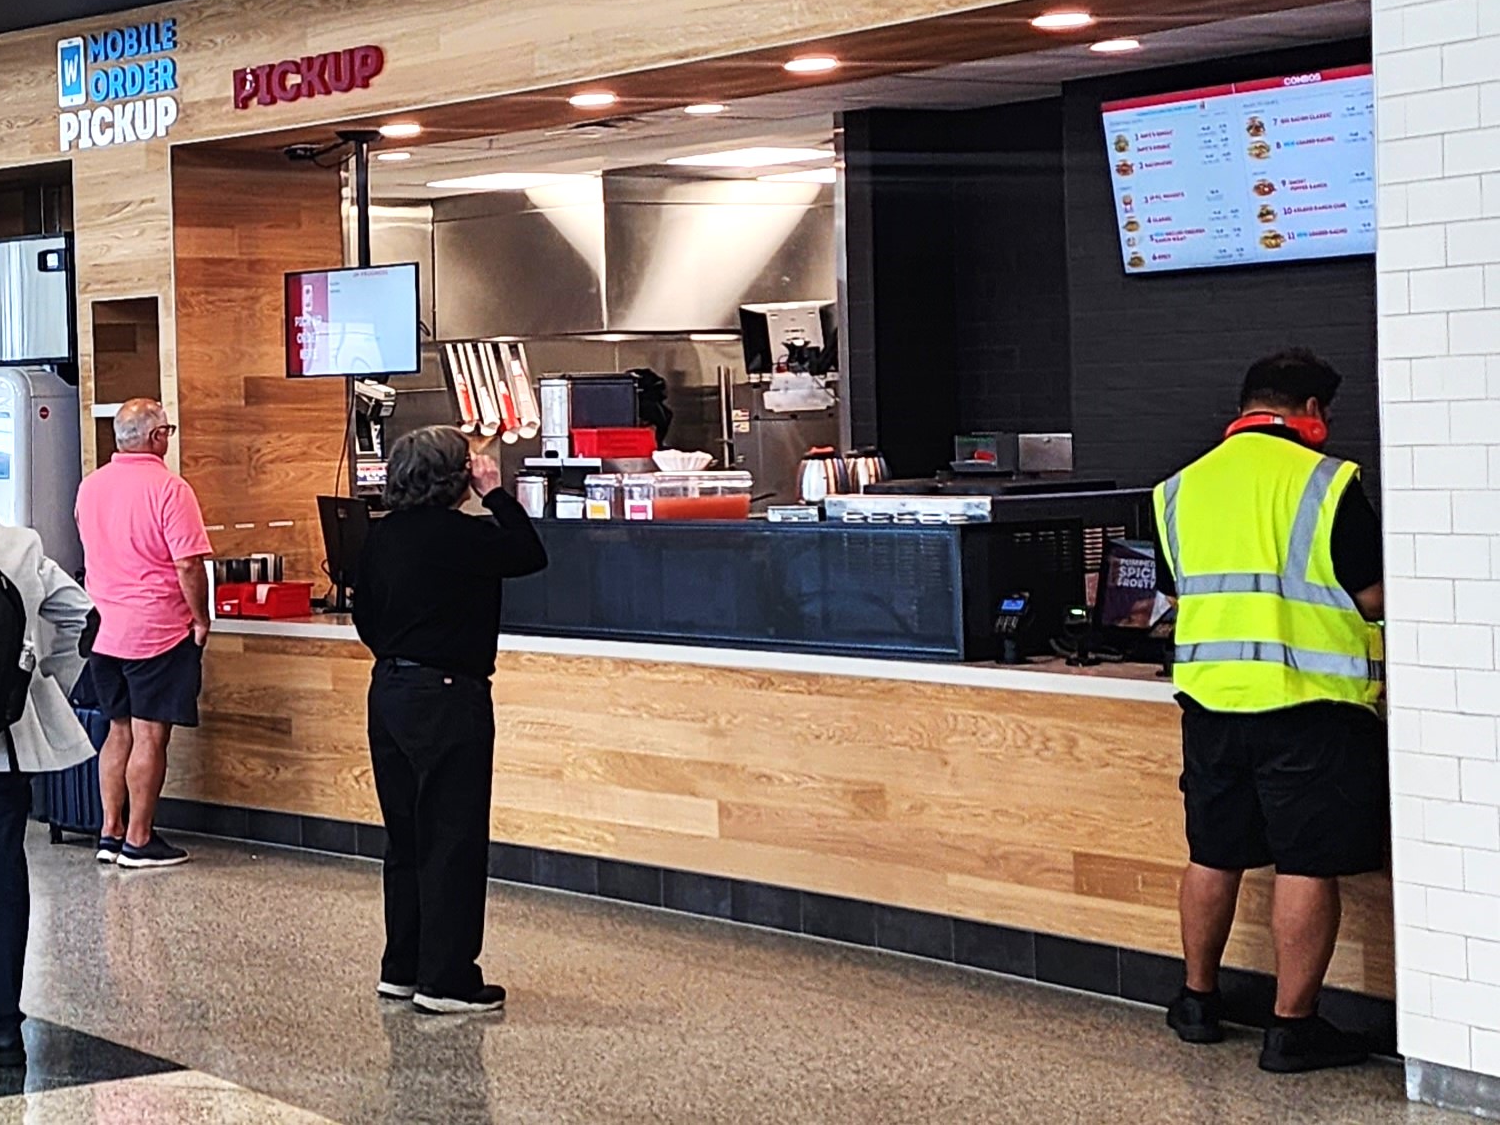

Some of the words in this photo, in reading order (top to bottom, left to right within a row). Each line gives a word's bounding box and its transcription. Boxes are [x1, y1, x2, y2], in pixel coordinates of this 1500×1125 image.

[89, 19, 177, 63] MOBILE
[90, 57, 178, 103] ORDER
[233, 44, 385, 110] PICKUP
[1284, 72, 1322, 87] COMBOS
[58, 96, 179, 152] PICKUP
